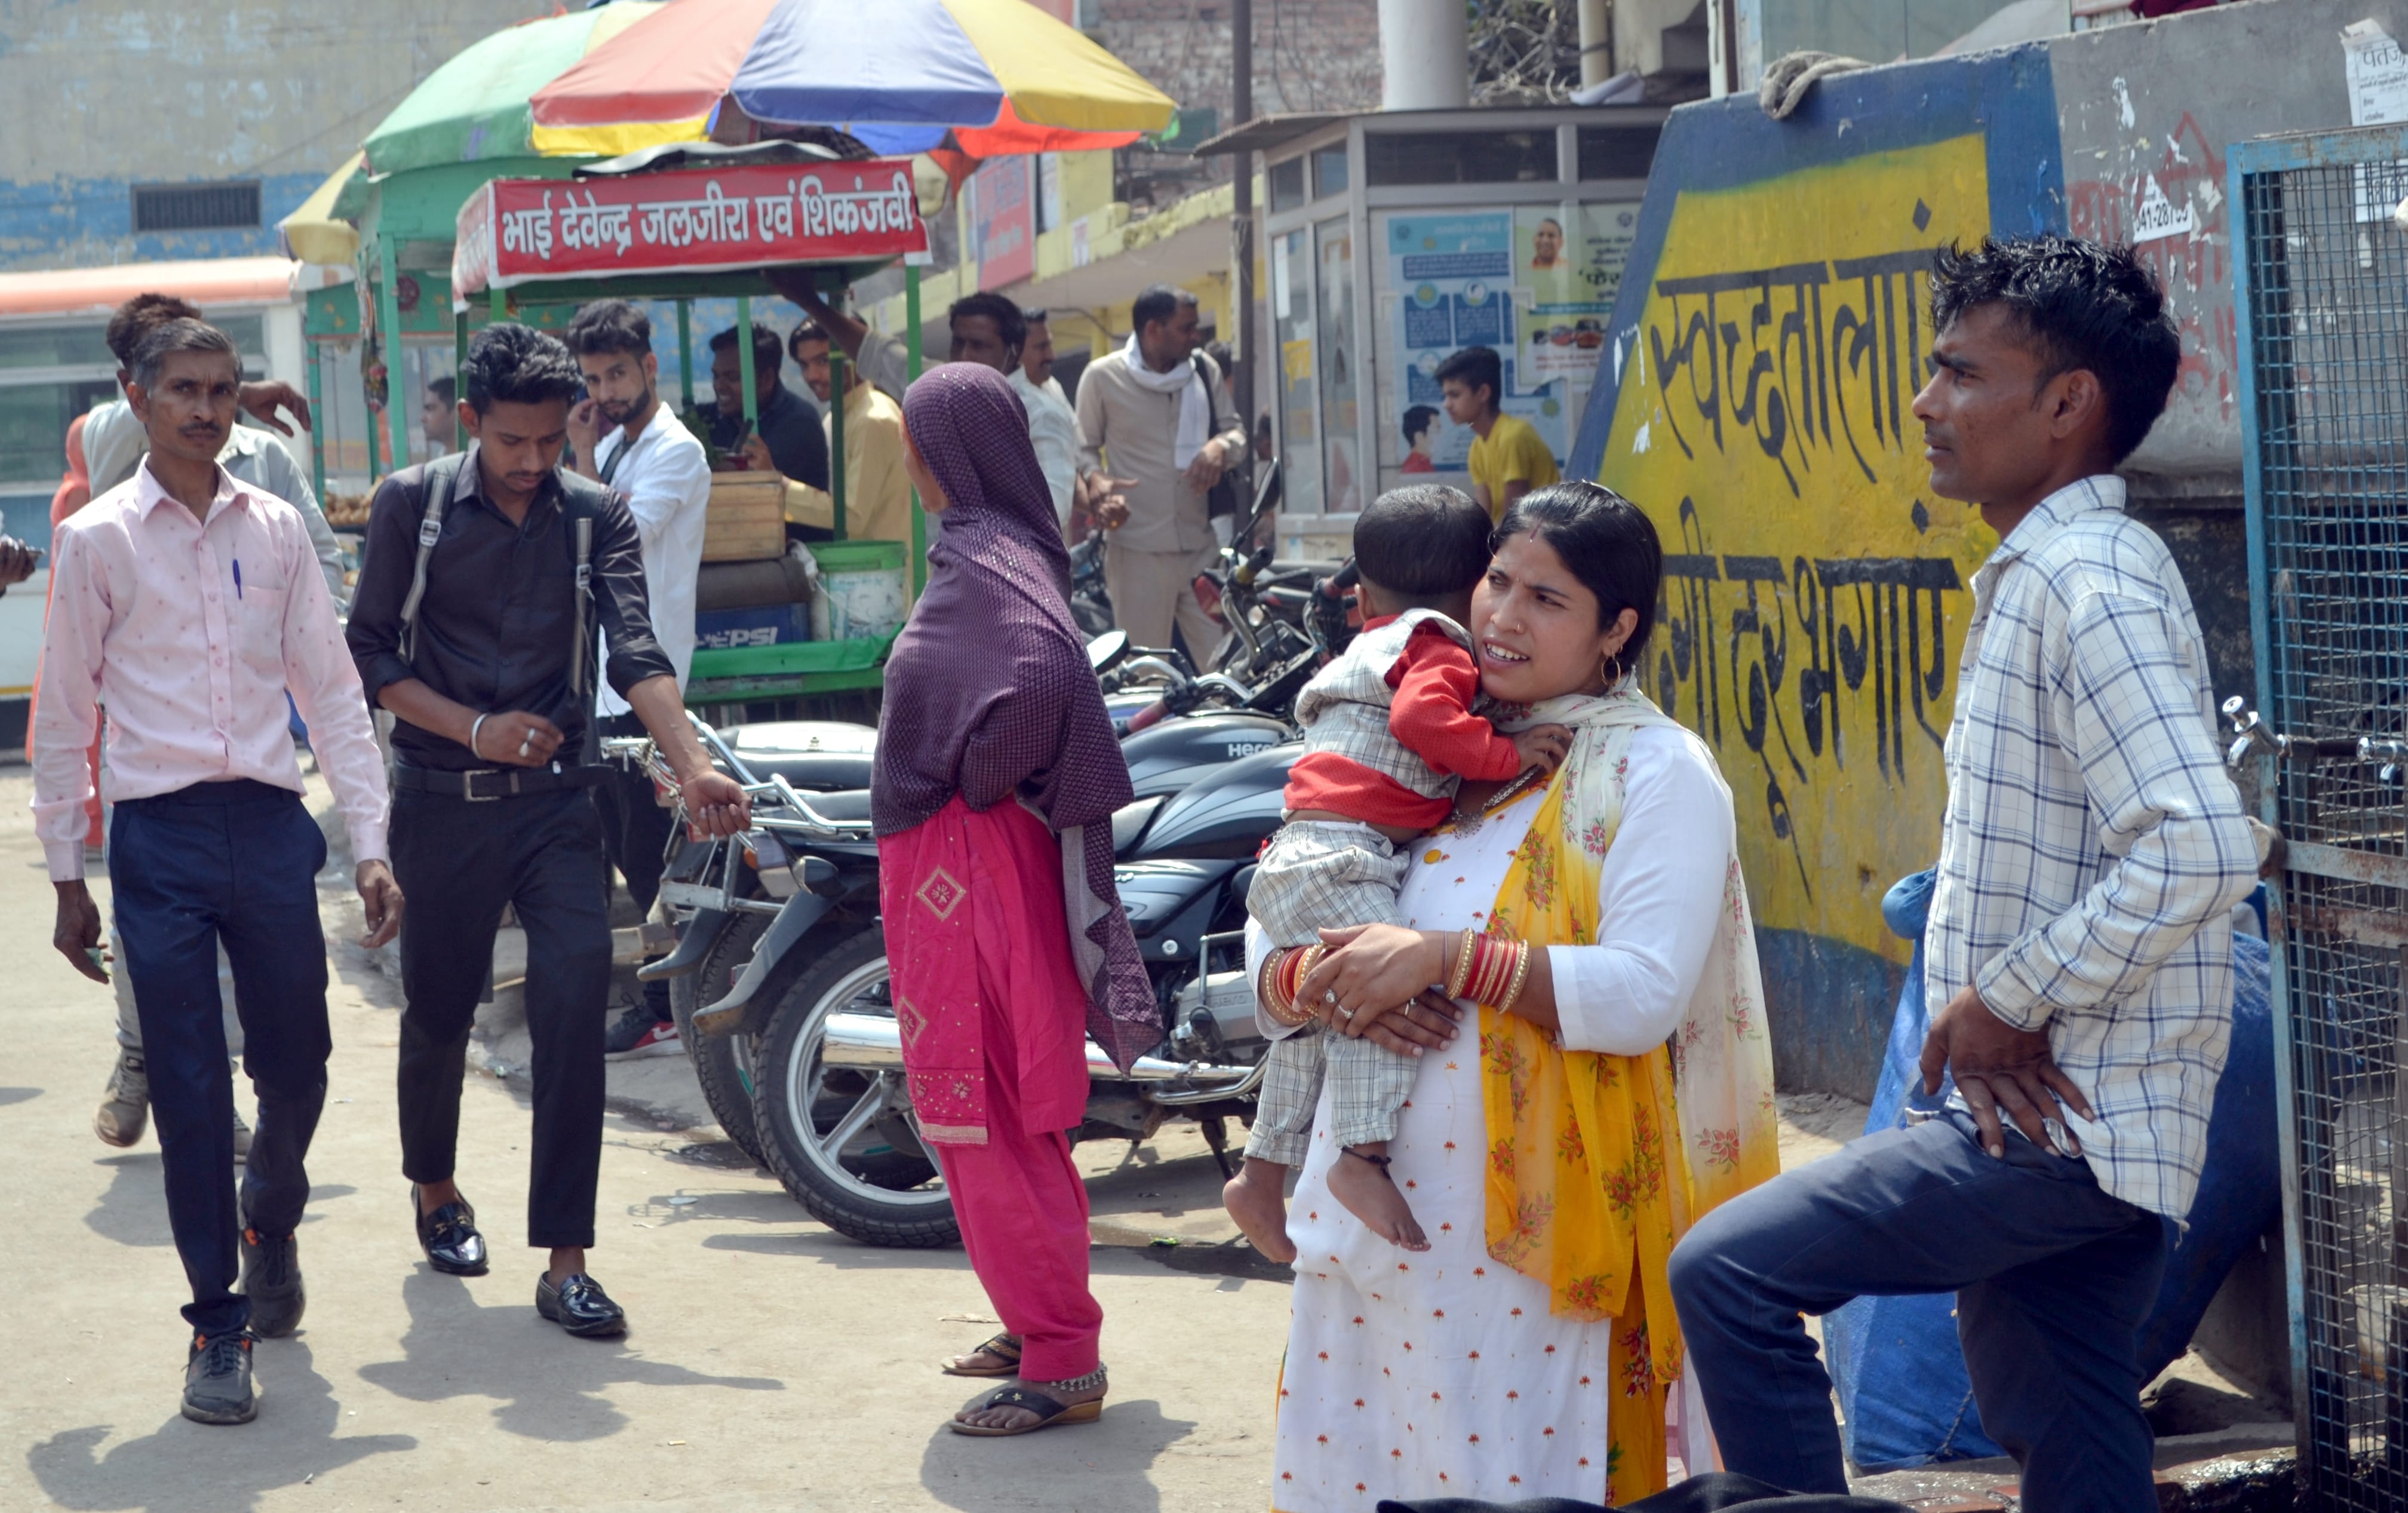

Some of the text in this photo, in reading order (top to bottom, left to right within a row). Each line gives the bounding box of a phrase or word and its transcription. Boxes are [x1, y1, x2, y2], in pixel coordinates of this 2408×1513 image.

[502, 189, 554, 260] भाई
[559, 188, 632, 257] देवेन्द्र
[637, 180, 749, 248] जलजीरा
[754, 179, 794, 243] एवं
[798, 170, 914, 238] शिकंजवी
[1723, 554, 1814, 913] दूर
